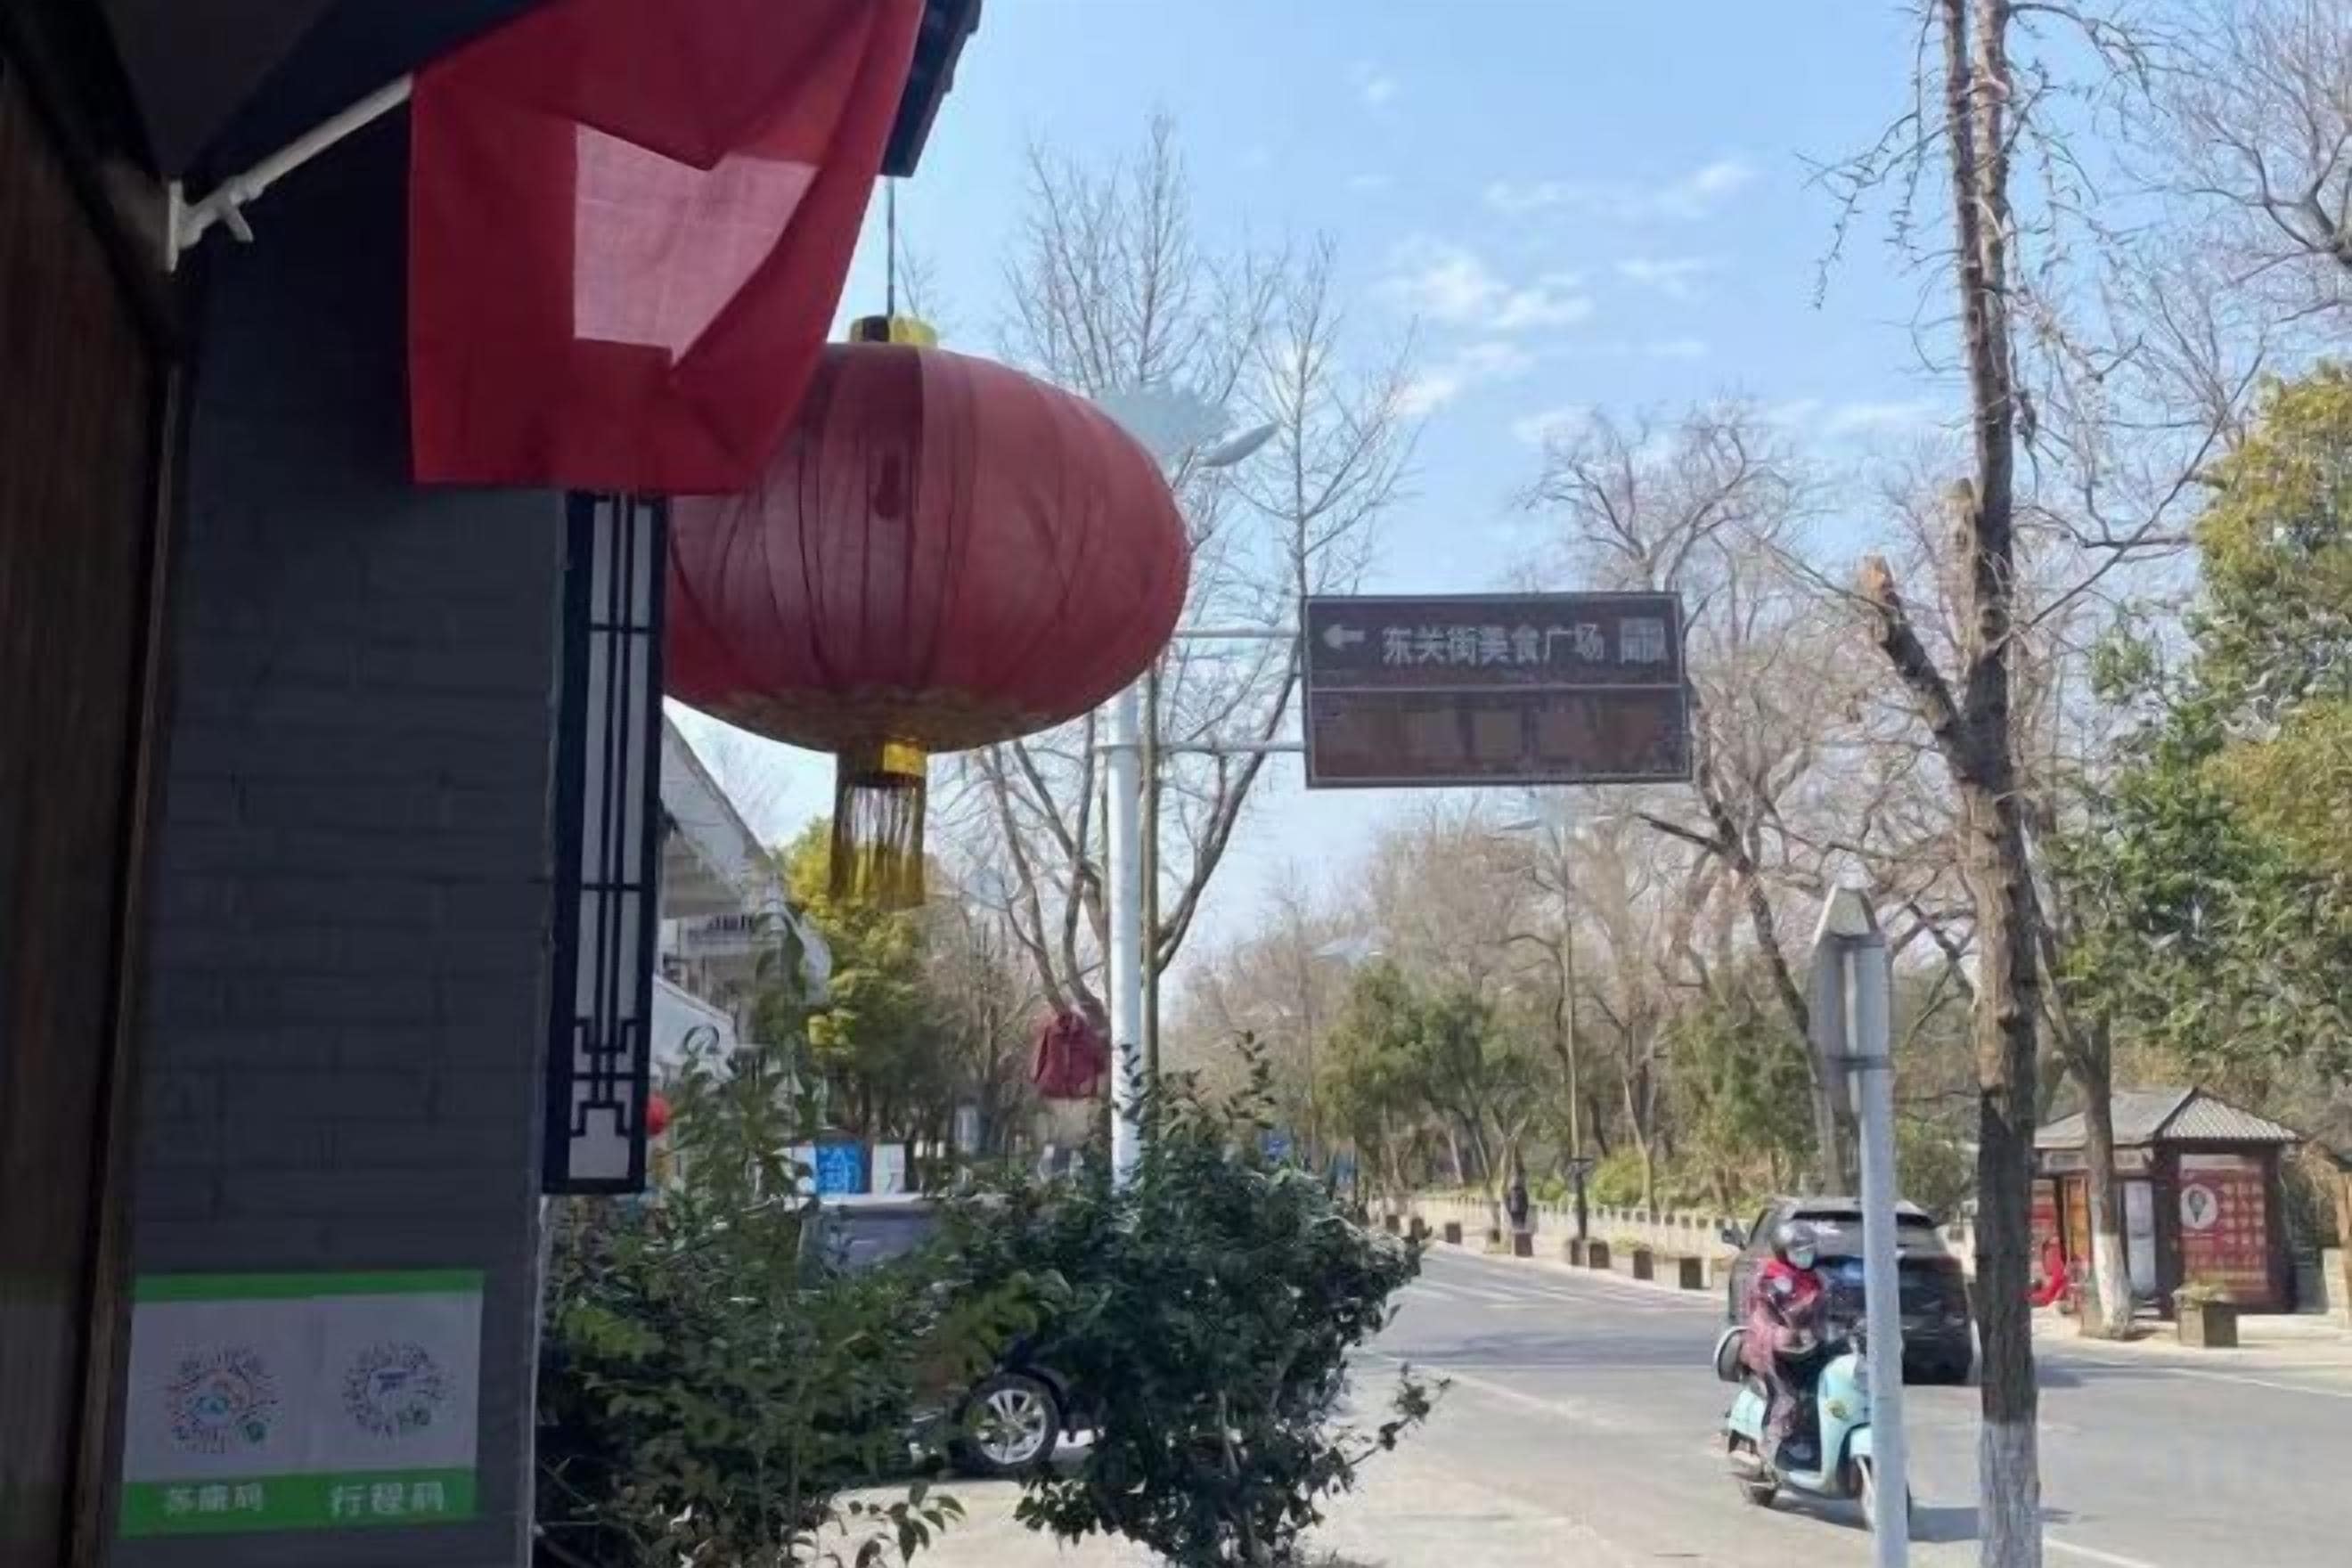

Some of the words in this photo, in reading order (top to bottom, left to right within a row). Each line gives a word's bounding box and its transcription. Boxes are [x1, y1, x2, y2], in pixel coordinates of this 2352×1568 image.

[1382, 623, 1605, 666] 东关街美食广场
